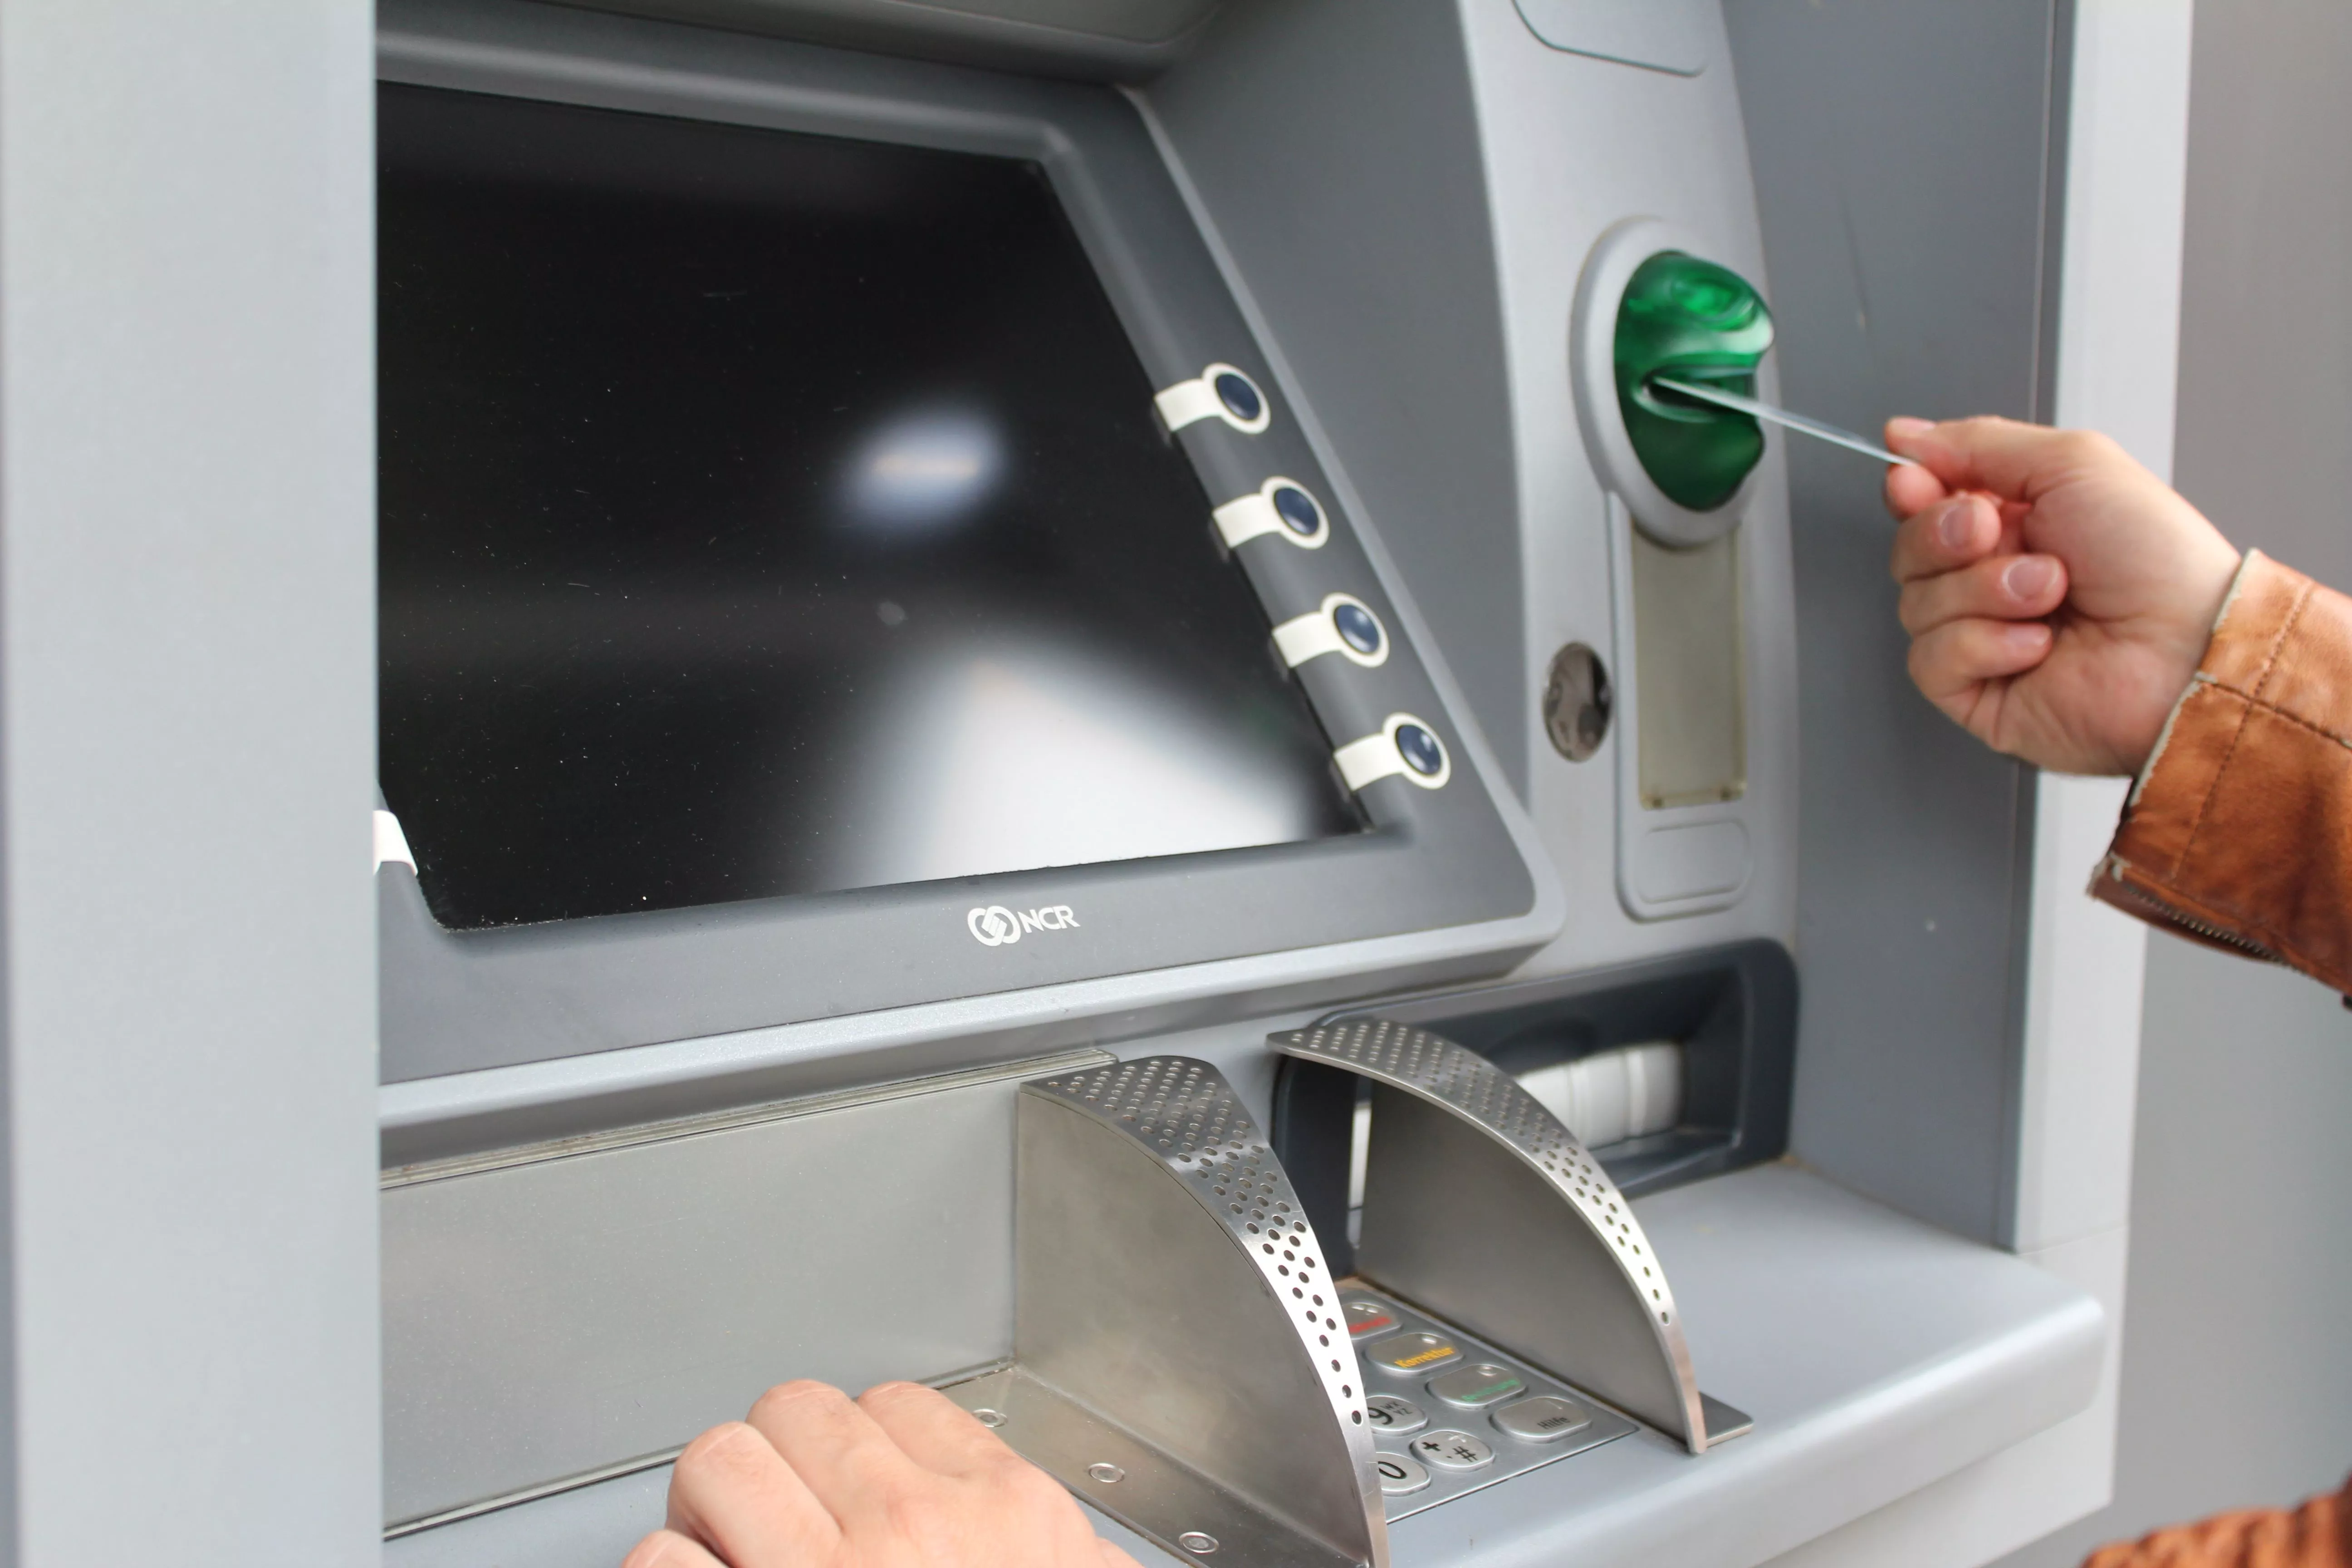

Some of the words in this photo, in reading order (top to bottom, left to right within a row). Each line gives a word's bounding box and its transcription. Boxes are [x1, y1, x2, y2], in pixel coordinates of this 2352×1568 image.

[1017, 906, 1081, 933] NCR
[1394, 1347, 1455, 1368] Korrektur
[1367, 1407, 1393, 1425] 9
[1537, 1417, 1570, 1430] Hilfe
[1452, 1446, 1478, 1462] #
[1378, 1461, 1406, 1479] 0
